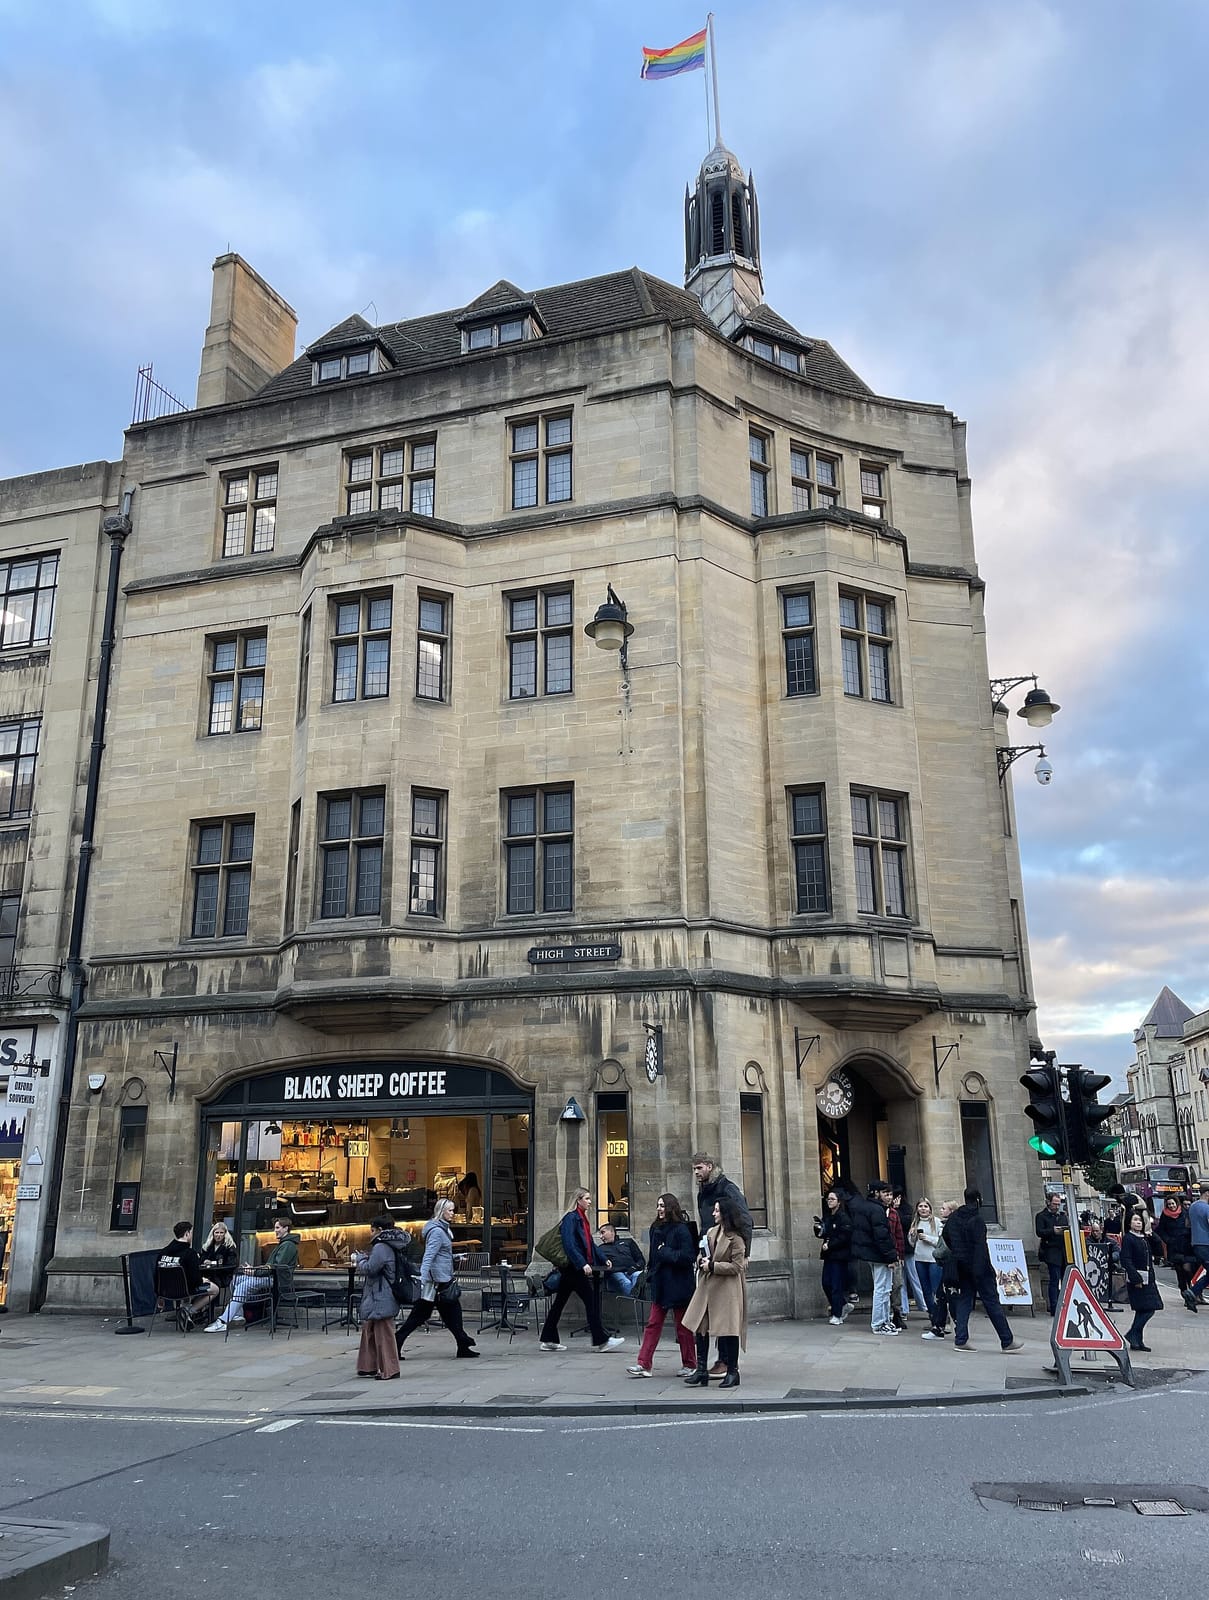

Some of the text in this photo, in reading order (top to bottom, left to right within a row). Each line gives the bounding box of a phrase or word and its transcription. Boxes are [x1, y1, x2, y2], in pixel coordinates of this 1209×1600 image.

[536, 947, 612, 959] HIGH STREET
[0, 1038, 18, 1066] S
[14, 1081, 33, 1092] OXFORD
[284, 1071, 447, 1100] BLACK SHEEP COFFEE
[8, 1093, 36, 1105] SOUVENIRS
[825, 1097, 852, 1116] COFFEE
[349, 1142, 369, 1155] PICK UP
[607, 1142, 625, 1155] DER
[1088, 1244, 1109, 1269] SHEEP
